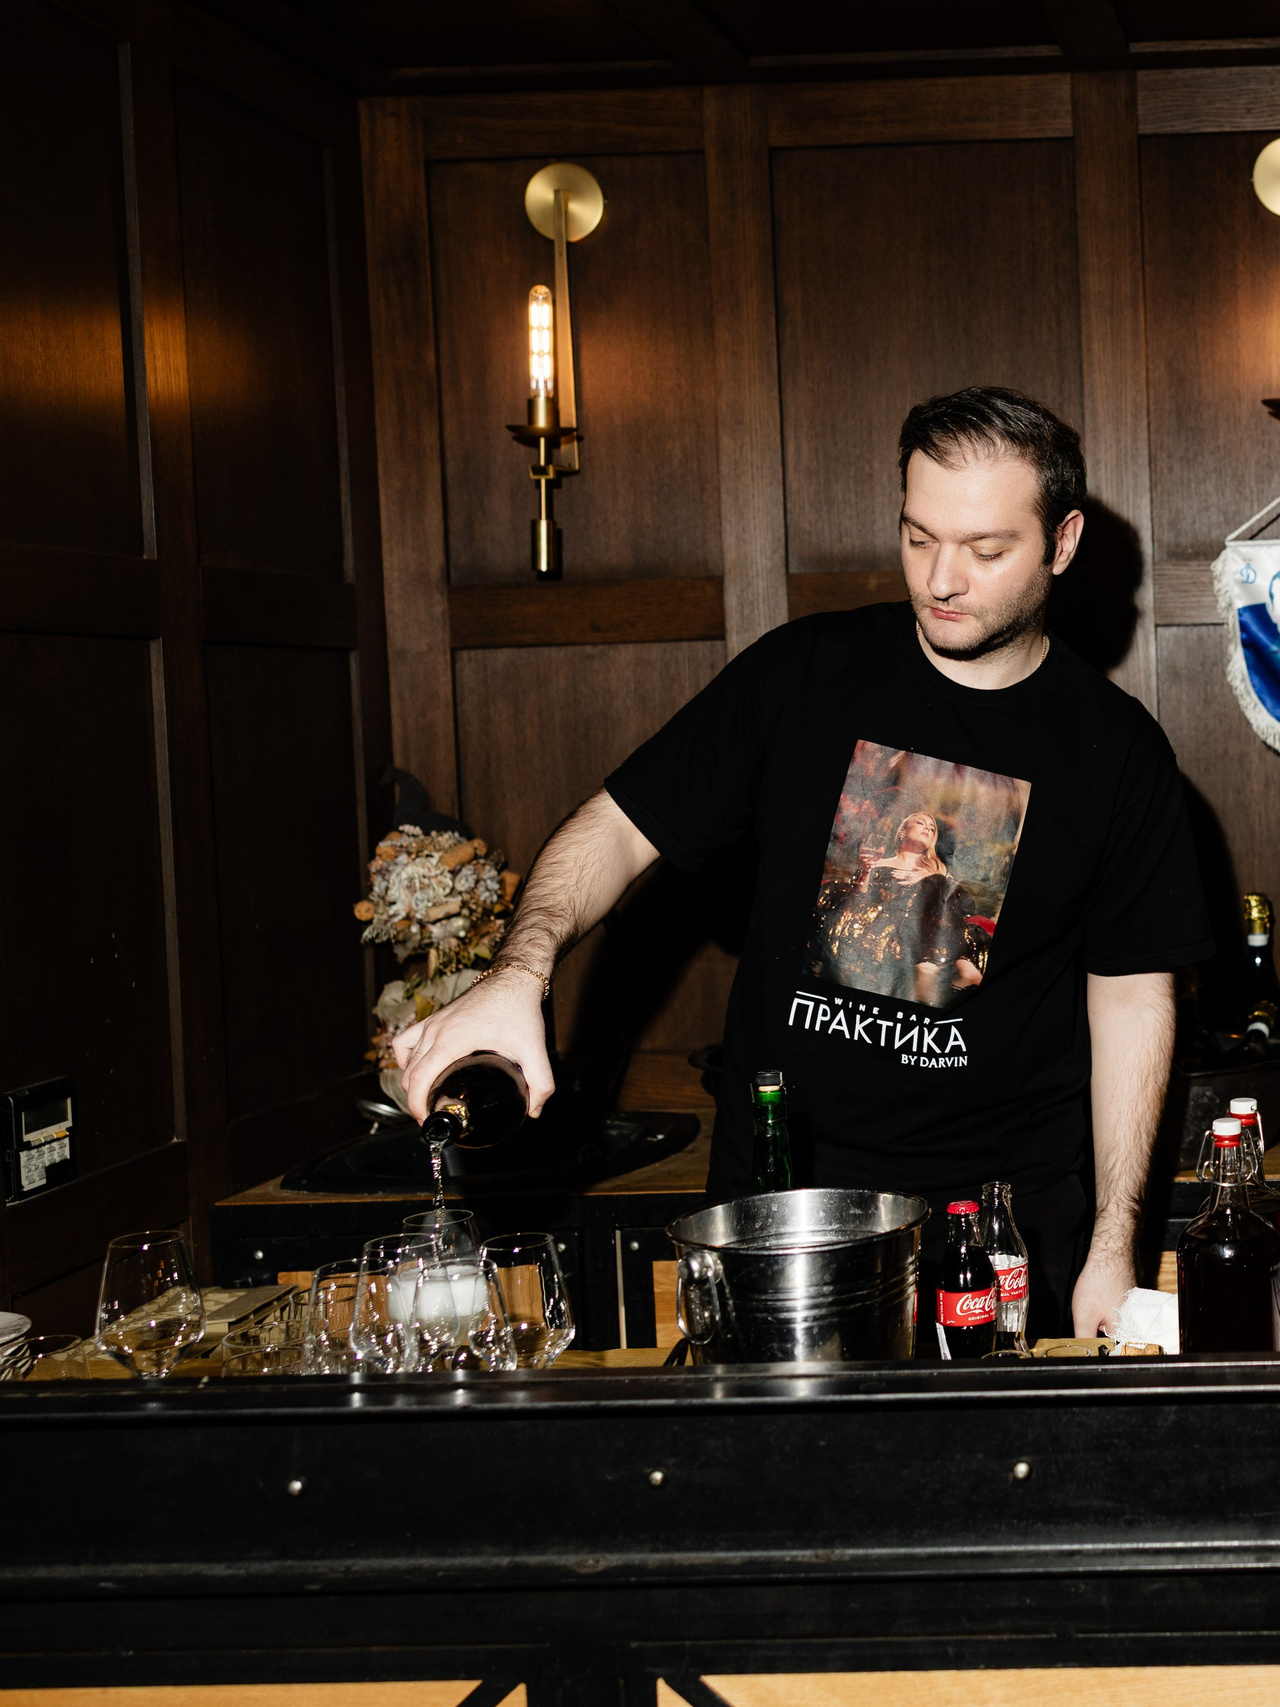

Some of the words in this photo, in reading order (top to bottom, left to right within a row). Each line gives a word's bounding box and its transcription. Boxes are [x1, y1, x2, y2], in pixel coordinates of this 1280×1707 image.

[834, 997, 880, 1015] WINE
[896, 1011, 931, 1025] BAR
[788, 997, 967, 1054] ПРАКТИКА
[901, 1053, 919, 1066] BY
[919, 1055, 969, 1069] DARVIN
